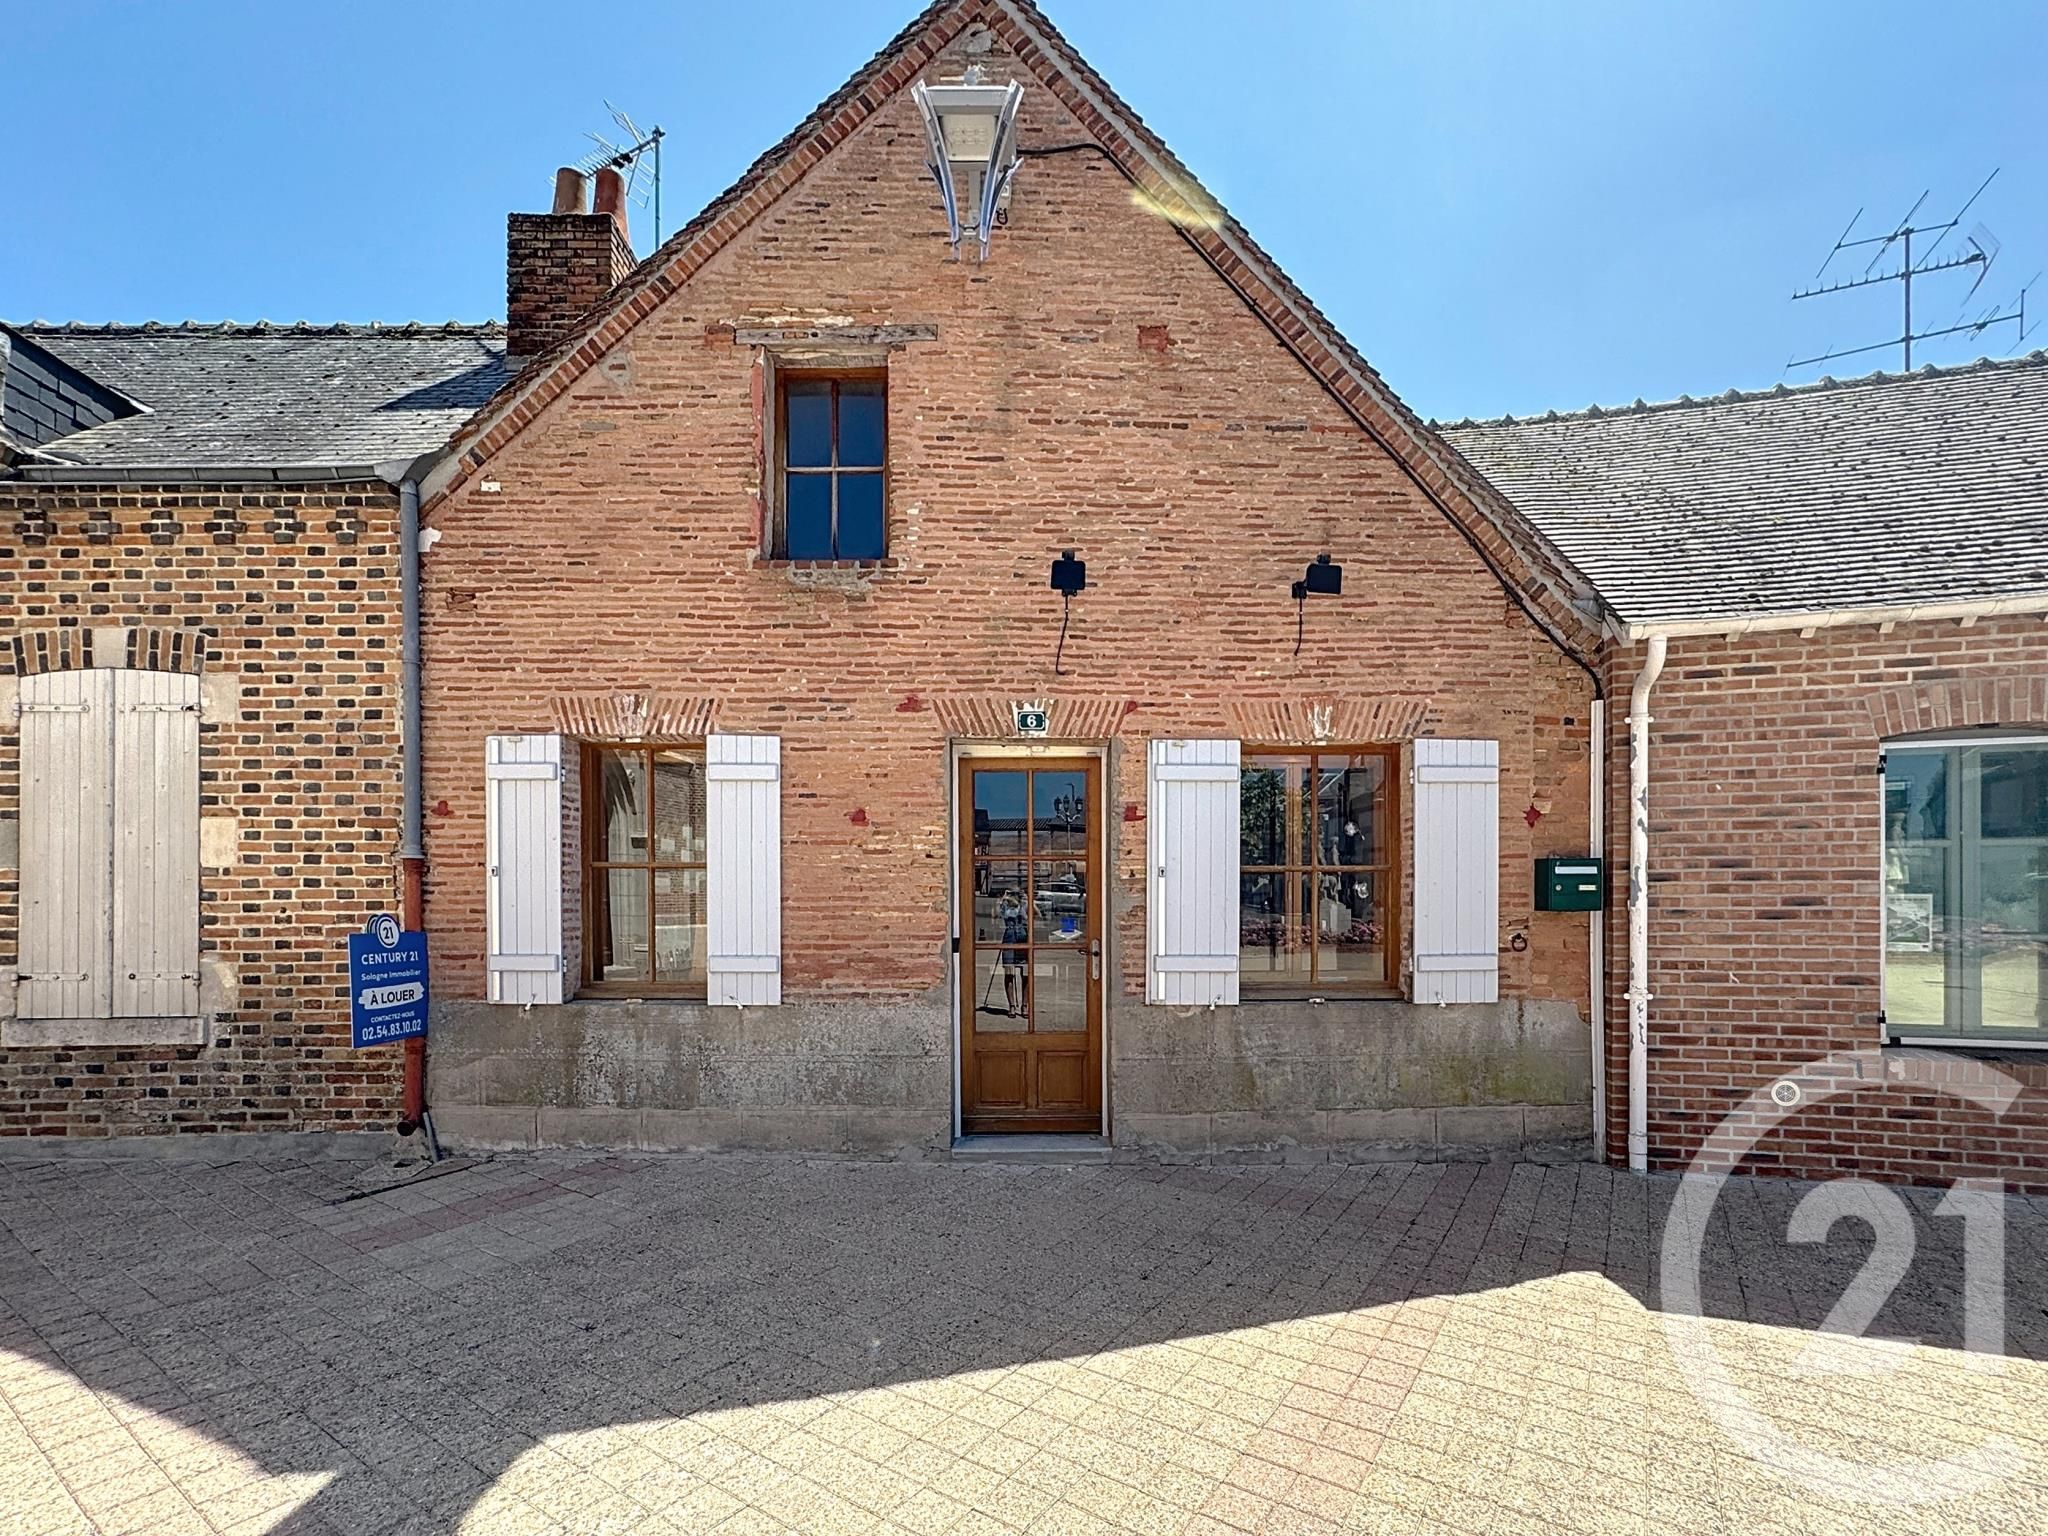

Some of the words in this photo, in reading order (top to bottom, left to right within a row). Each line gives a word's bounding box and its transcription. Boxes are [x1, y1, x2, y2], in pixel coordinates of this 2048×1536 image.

[1027, 715, 1036, 727] 6
[383, 927, 394, 939] 21
[361, 951, 408, 965] CENTURY
[409, 951, 419, 961] 21
[361, 973, 388, 982] Sologne
[389, 969, 421, 978] Immobilier
[370, 990, 379, 1005] À
[381, 989, 415, 1004] LOUER
[362, 1019, 422, 1040] 02.54.83.10.02
